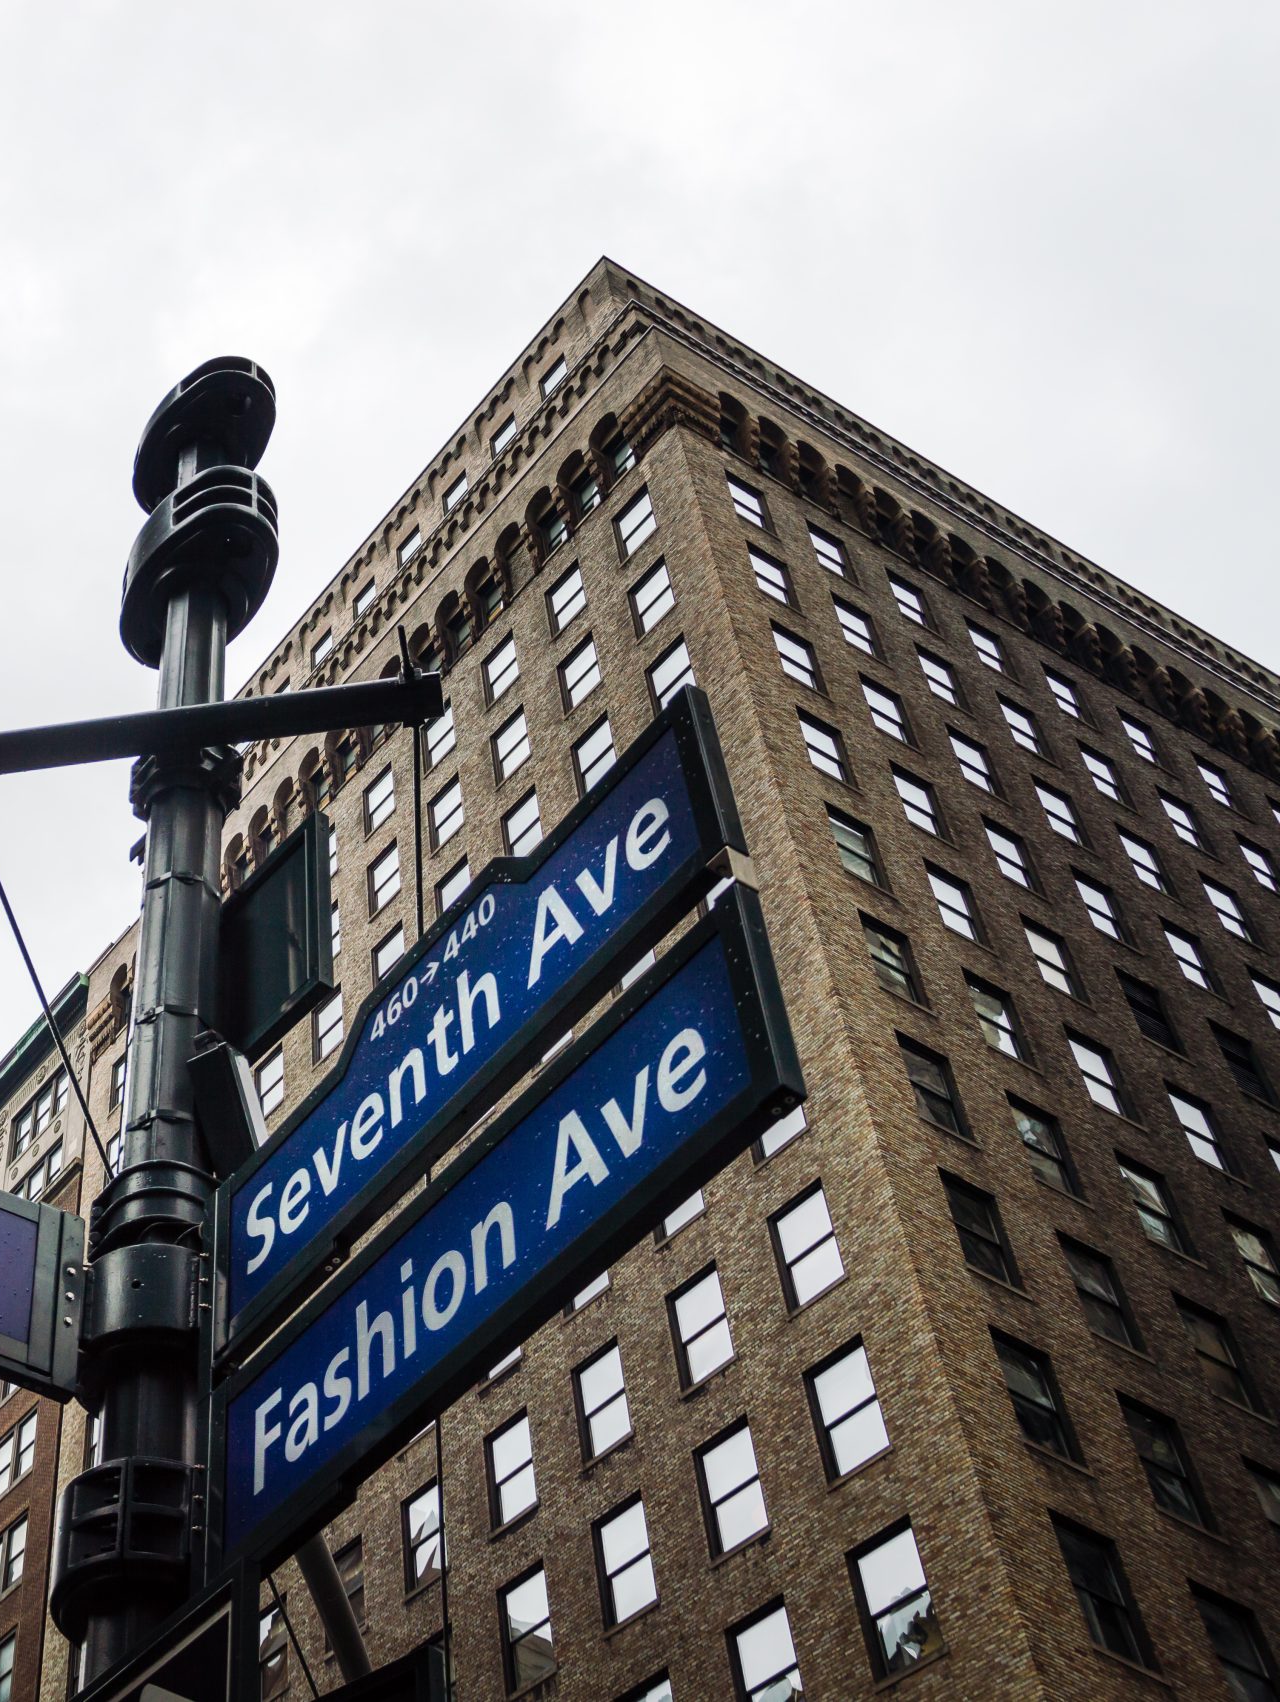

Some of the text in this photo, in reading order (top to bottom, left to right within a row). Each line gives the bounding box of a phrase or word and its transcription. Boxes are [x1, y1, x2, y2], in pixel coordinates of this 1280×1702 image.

[245, 797, 671, 1276] Seventh Ave
[370, 893, 496, 1043] 460 440
[253, 1028, 707, 1495] Fashion Ave
